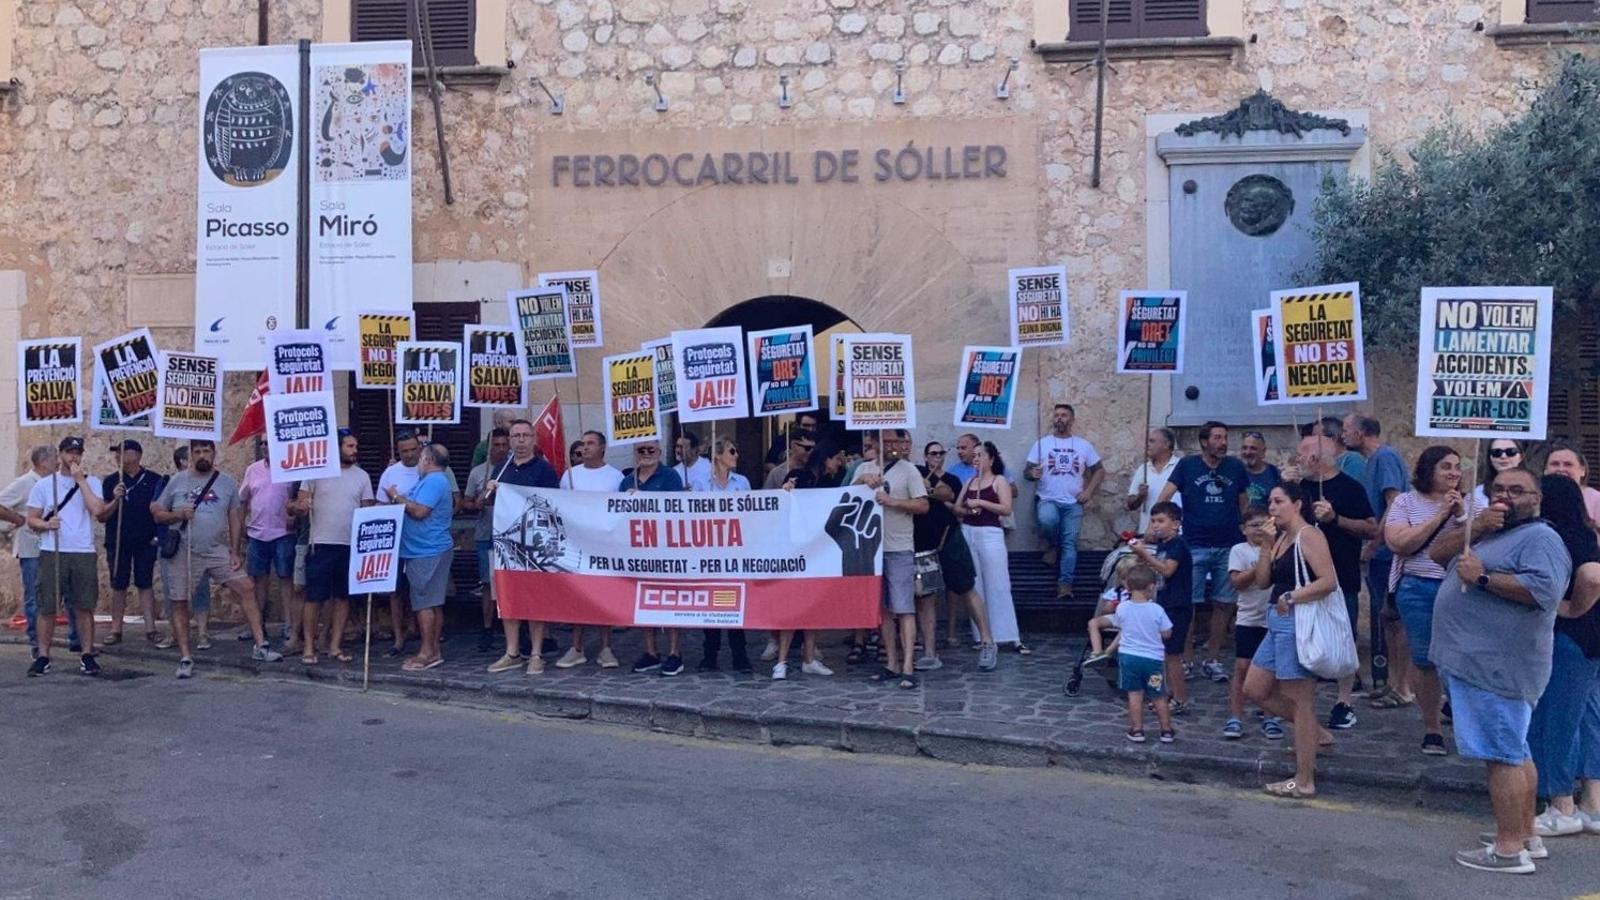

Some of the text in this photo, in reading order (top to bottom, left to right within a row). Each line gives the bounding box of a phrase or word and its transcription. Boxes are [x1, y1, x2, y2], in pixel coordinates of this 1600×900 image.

[552, 140, 1007, 188] FERROCARRIL DE SÓLLER
[207, 202, 232, 213] Sala
[320, 200, 346, 211] Sala
[206, 218, 289, 237] Picasso
[319, 213, 378, 237] Miró
[1018, 276, 1060, 291] SENSE
[519, 297, 539, 315] NO
[1017, 290, 1061, 304] SEGURETAT
[1018, 305, 1062, 322] NO HI HA
[1131, 306, 1177, 320] SEGURETAT
[1309, 304, 1326, 321] LA
[1439, 301, 1534, 329] NO VOLEM
[379, 323, 391, 333] LA
[1141, 321, 1172, 342] DRET
[1286, 320, 1353, 342] SEGURETAT
[485, 335, 507, 355] LA
[761, 339, 769, 347] LA
[761, 342, 805, 360] SEGURETAT
[1438, 331, 1530, 353] LAMENTAR
[40, 349, 60, 368] LA
[114, 345, 138, 366] LA
[278, 346, 320, 359] Protocols
[368, 348, 388, 362] NO
[419, 352, 441, 370] LA
[687, 345, 731, 361] Protocols
[853, 345, 902, 360] SENSE
[1294, 341, 1349, 363] NO ES
[27, 364, 75, 382] PREVENCIÓ
[109, 355, 155, 382] PREVENCIÓ
[168, 357, 216, 374] SENSE
[279, 358, 322, 374] seguretat
[626, 366, 638, 380] LA
[688, 361, 734, 378] seguretat
[773, 358, 801, 380] DRET
[852, 361, 904, 376] SEGURETAT
[972, 361, 1013, 375] SEGURETAT
[1287, 362, 1356, 386] NEGOCIA
[116, 371, 158, 399] SALVA
[166, 371, 216, 388] SEGURETAT
[405, 369, 454, 383] PREVENCIÓ
[474, 367, 519, 386] SALVA
[30, 382, 74, 402] SALVA
[407, 384, 451, 402] SALVA
[475, 386, 518, 402] VIDES
[613, 377, 653, 396] SEGURETAT
[688, 378, 737, 410] JA!!!
[853, 378, 905, 398] NO HI HA
[979, 375, 1008, 397] DRET
[1443, 380, 1502, 397] VOLEM
[122, 391, 157, 412] VIDE
[166, 387, 215, 405] NO HI HA
[618, 397, 634, 413] NO
[636, 394, 651, 409] ES
[31, 401, 73, 417] VIDES
[164, 406, 214, 421] FEINA DIGNA
[408, 402, 452, 418] VIDES
[853, 400, 905, 412] FEINA DIGNA
[1432, 398, 1529, 419] EVITAR-LOS
[278, 409, 324, 424] Protocols
[614, 410, 655, 431] NEGOCIA
[279, 423, 326, 440] seguretat
[280, 439, 328, 471] JA!!!
[607, 494, 779, 513] PERSONAL DEL TREN DE SÓLLER
[361, 522, 394, 535] Protocols
[630, 518, 743, 548] EN LLUITA
[359, 538, 393, 552] seguretat
[357, 553, 392, 580] JA!!!
[589, 555, 610, 570] PER
[612, 558, 625, 571] LA
[627, 558, 688, 573] SEGURETAT
[700, 559, 721, 573] PER
[725, 559, 739, 573] LA
[742, 555, 807, 573] NEGOCIACIÓ
[644, 589, 709, 607] CCOO
